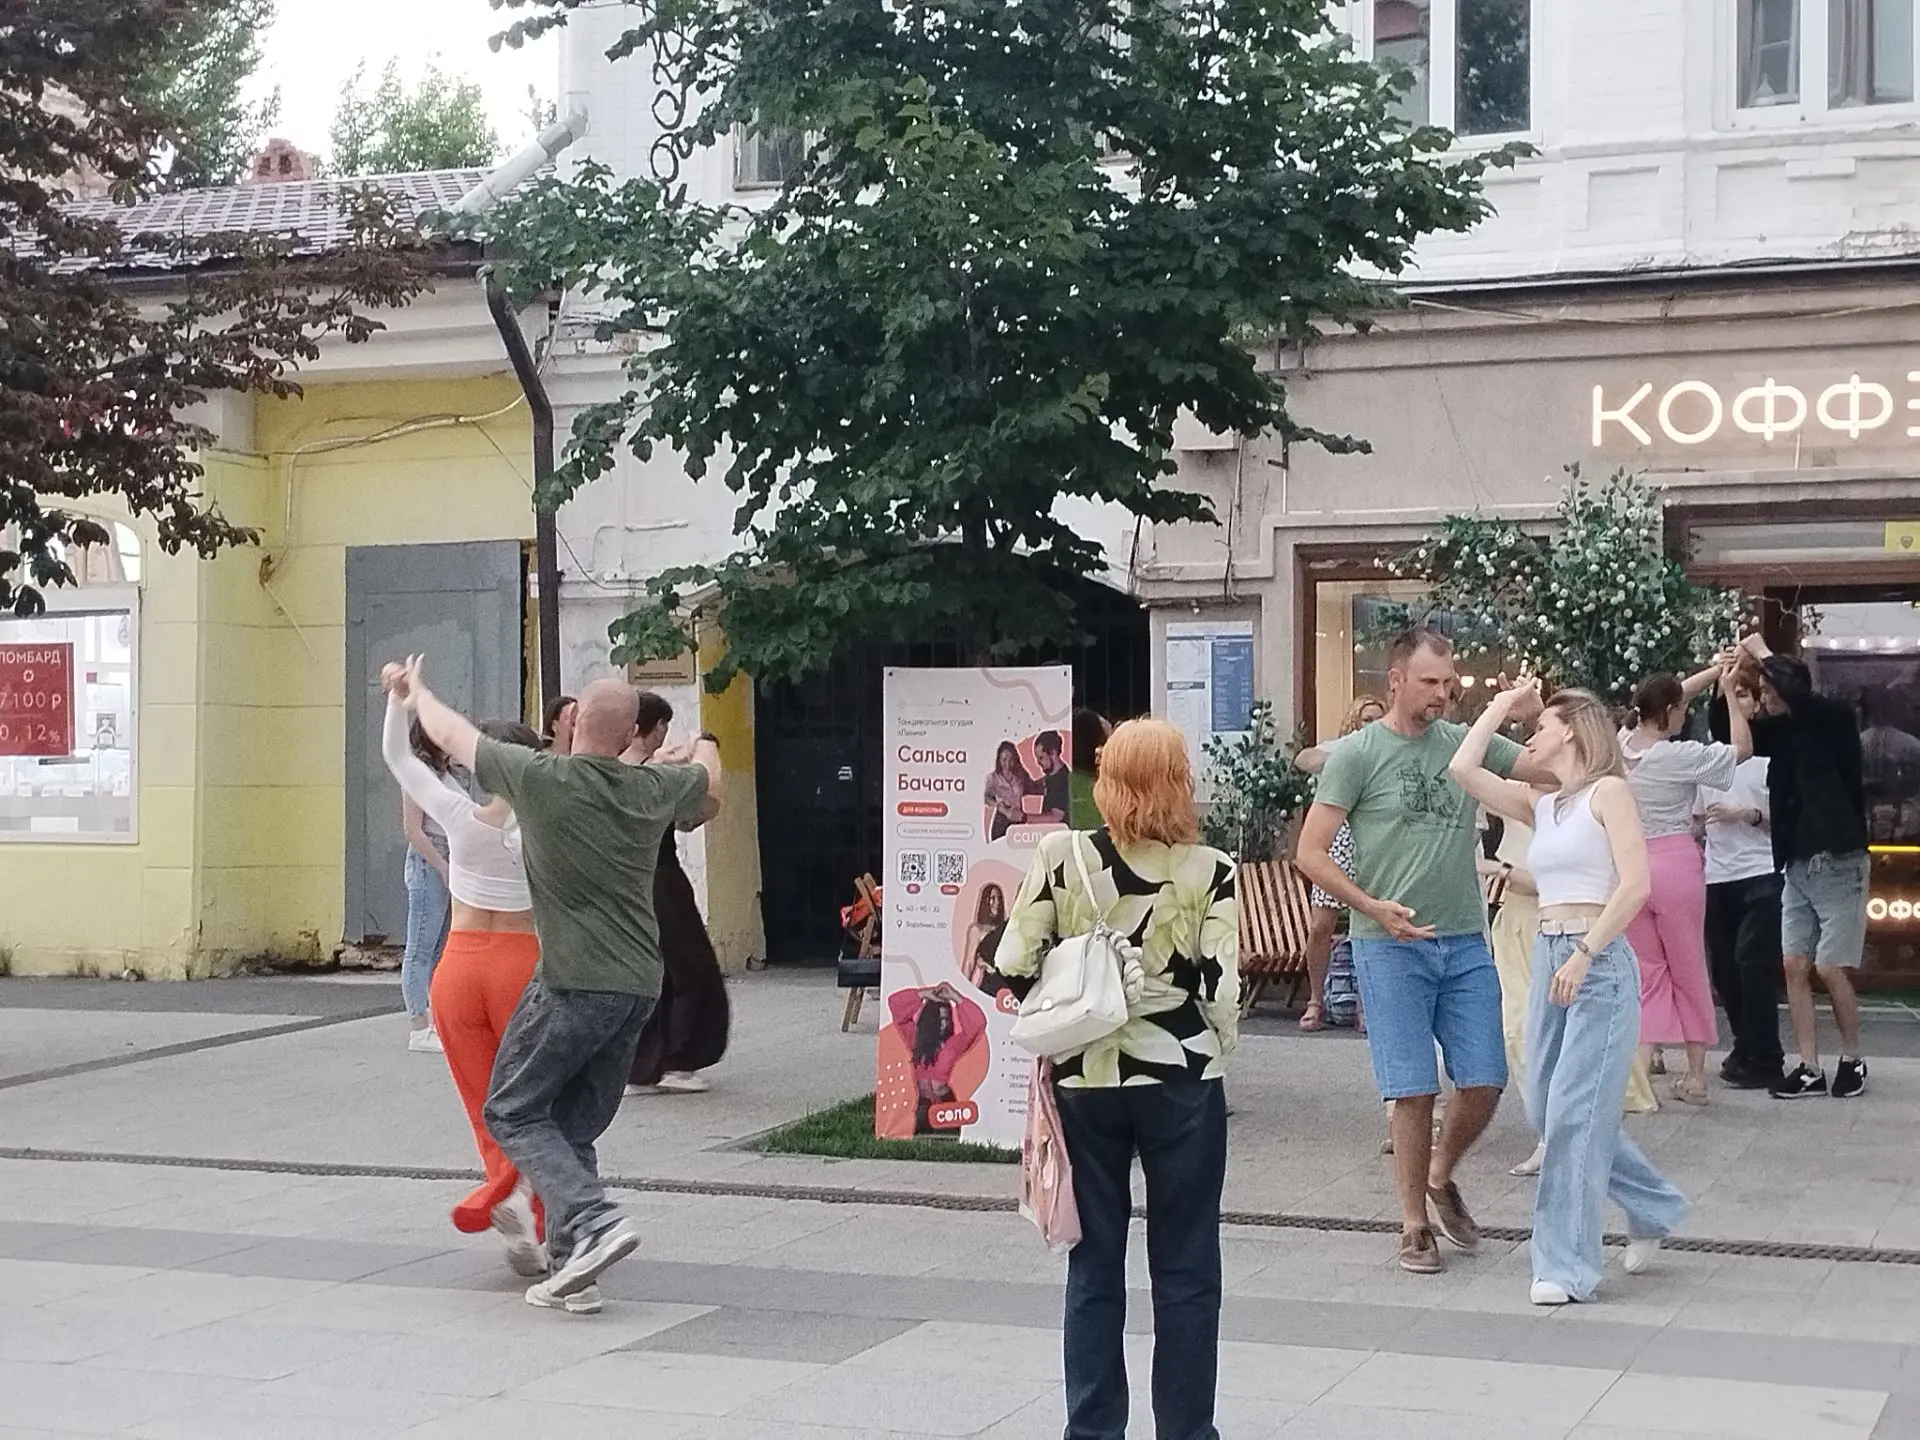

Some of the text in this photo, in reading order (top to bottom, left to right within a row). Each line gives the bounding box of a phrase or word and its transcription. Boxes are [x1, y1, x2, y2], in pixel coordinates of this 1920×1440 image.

[898, 745, 967, 763] Сальса
[898, 773, 966, 792] Бачата
[936, 1107, 972, 1123] соло
